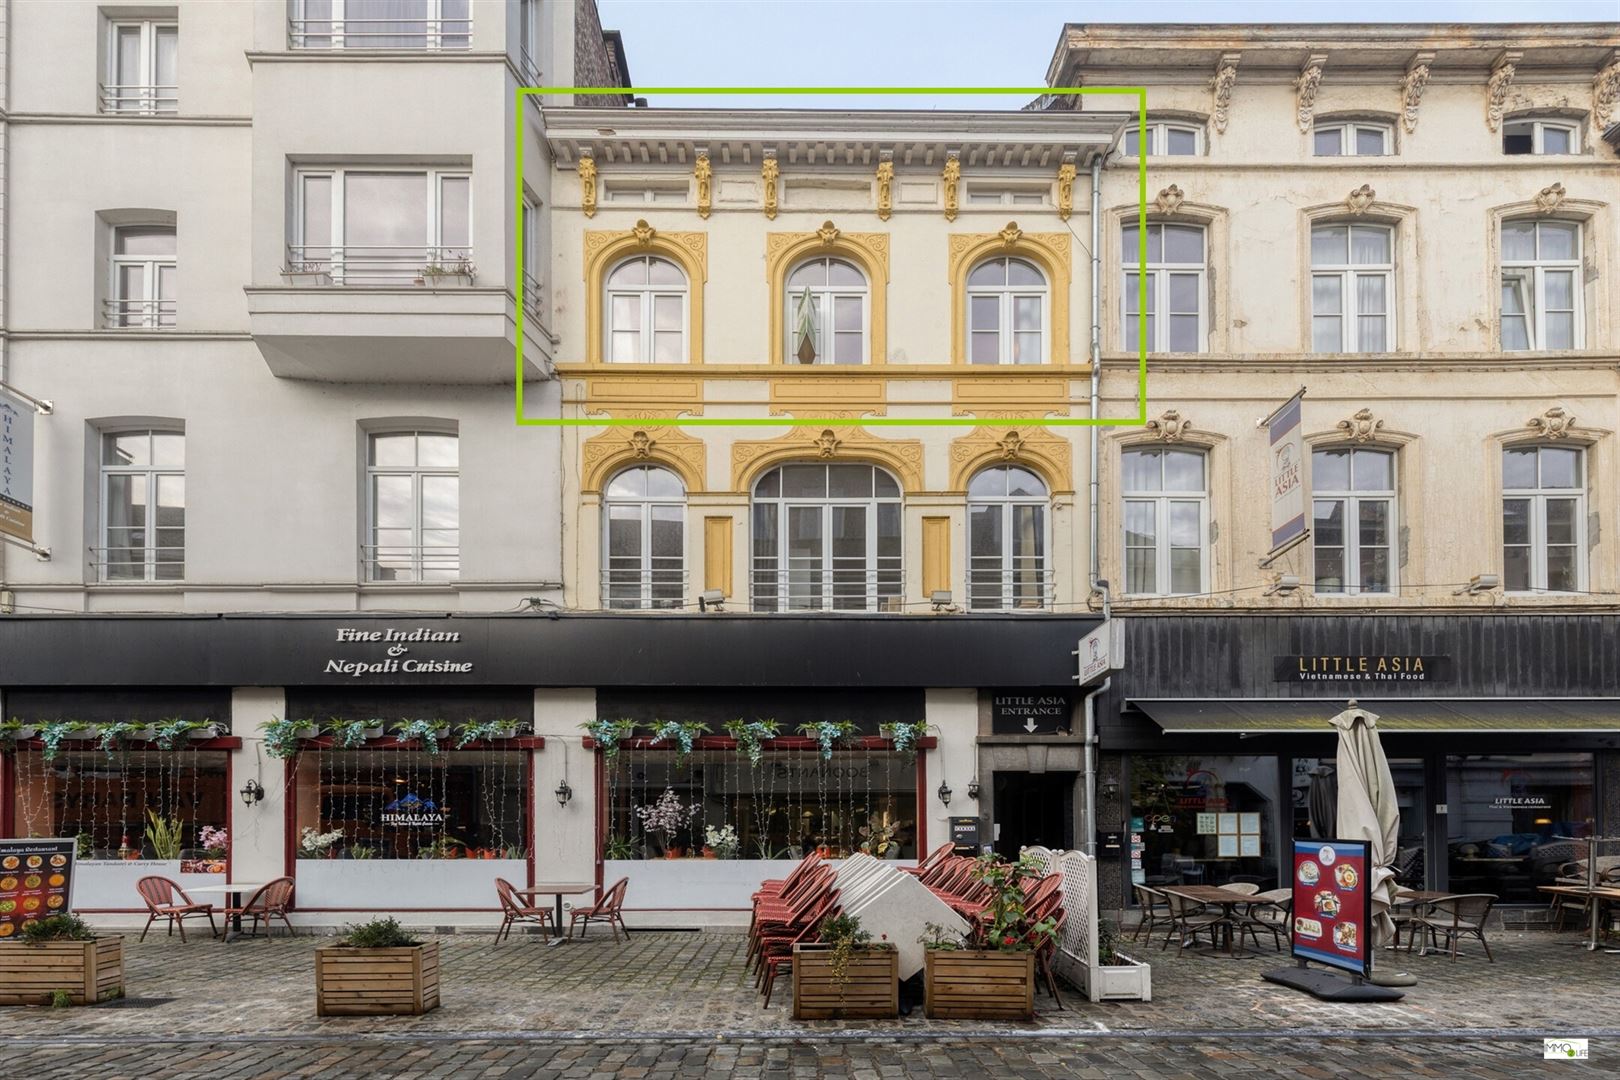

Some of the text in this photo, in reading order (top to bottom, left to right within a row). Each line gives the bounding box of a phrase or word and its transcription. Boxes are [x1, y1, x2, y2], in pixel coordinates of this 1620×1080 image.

[3, 414, 12, 495] HIMALAYA
[1275, 463, 1299, 487] LITTLE
[1275, 474, 1299, 499] ASIA
[336, 628, 461, 642] Fine Indian
[387, 644, 408, 657] &
[324, 659, 473, 677] Nepali Cuisine
[1300, 657, 1424, 672] LITTLE ASIA
[996, 697, 1066, 705] LITTLE ASIA
[1001, 707, 1062, 715] ENTRANCE
[381, 813, 443, 822] HIMALAYA
